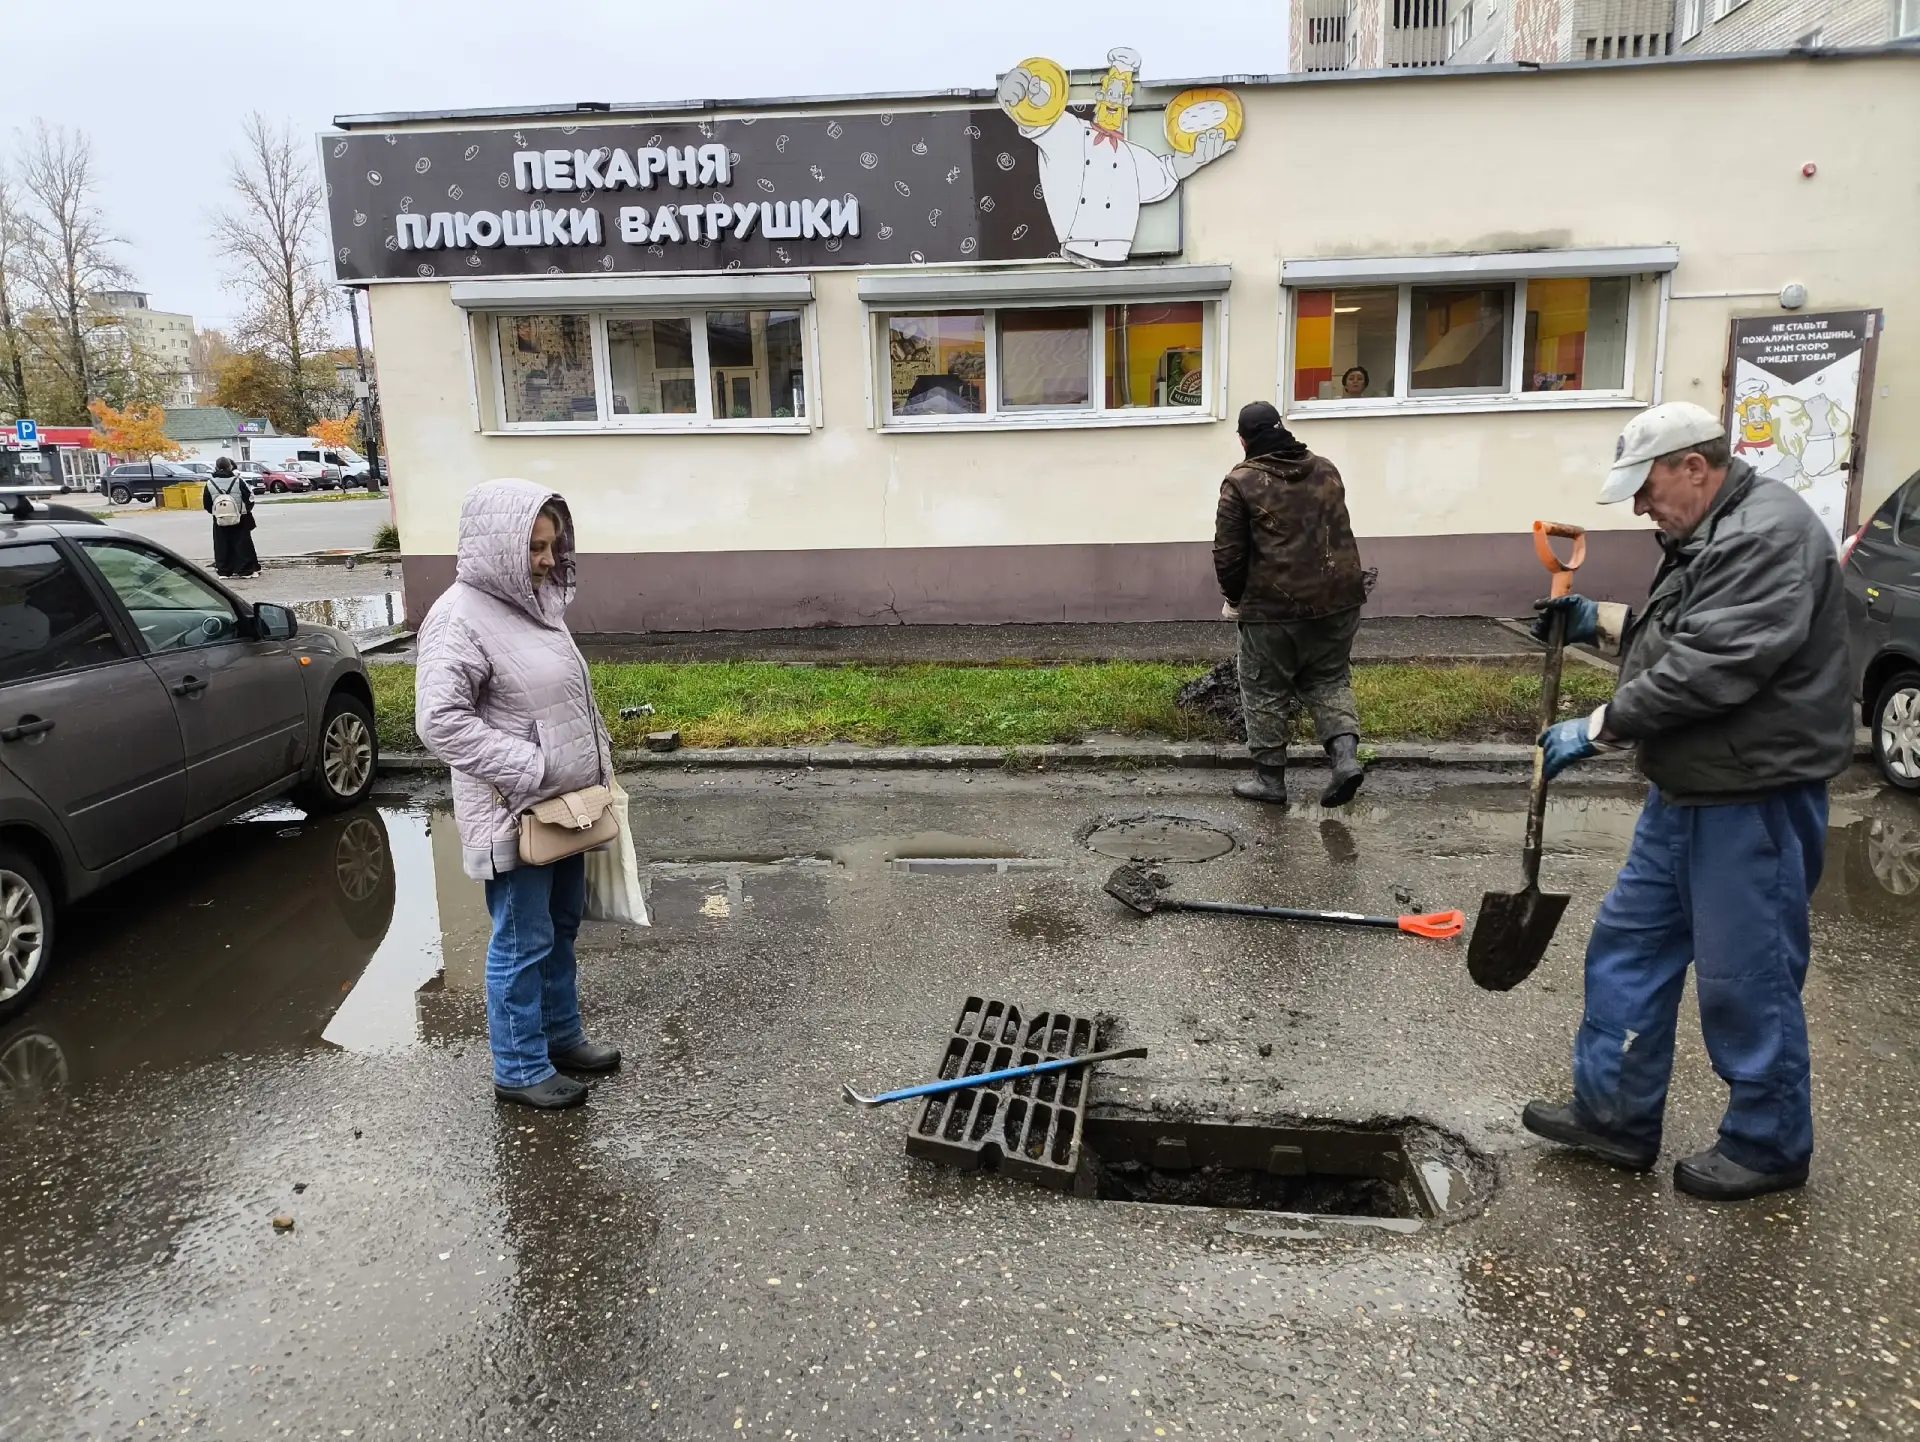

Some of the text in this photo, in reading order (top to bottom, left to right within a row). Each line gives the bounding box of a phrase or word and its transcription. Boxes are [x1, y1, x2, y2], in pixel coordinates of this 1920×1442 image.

[513, 144, 733, 193] ПЕКАРНЯ
[396, 198, 861, 251] ПЛЮШКИ ВАТРУШКИ
[1772, 321, 1828, 332] НЕ СТАВЬТЕ
[1742, 330, 1856, 344] ПОЖАЛУЙСТА МАШИНЫ,
[1765, 343, 1829, 353] К НАМ СКОРО
[1757, 352, 1837, 363] ПРИЕДЕТ ТОВАР!
[21, 421, 33, 439] P
